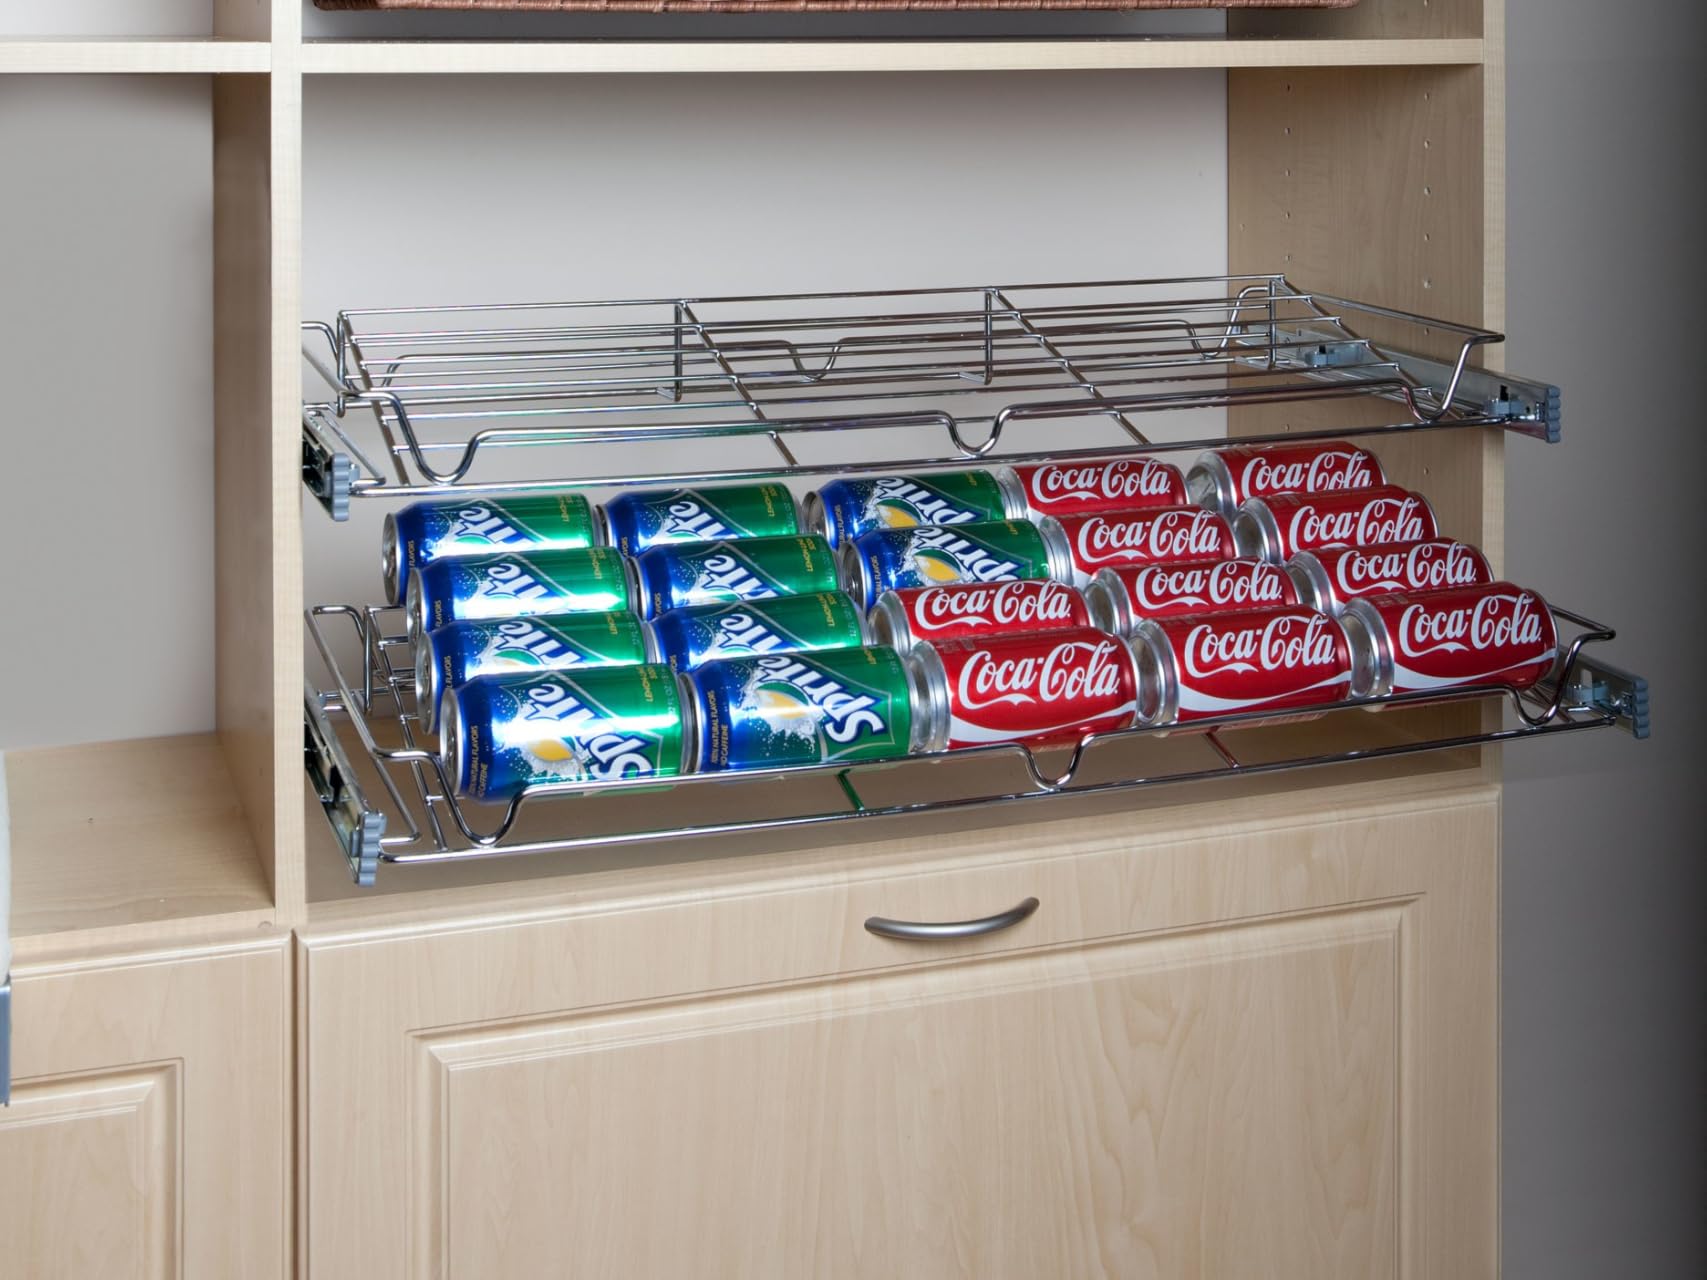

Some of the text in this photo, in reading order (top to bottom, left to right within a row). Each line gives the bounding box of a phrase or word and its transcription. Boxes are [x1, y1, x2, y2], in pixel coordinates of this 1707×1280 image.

[875, 477, 976, 525] prite
[1032, 458, 1170, 503] Coca-Cola
[1241, 451, 1373, 499] Coca-Cola
[1077, 510, 1221, 563] Coca-Cola
[1288, 498, 1425, 552] Coca-Cola
[1135, 559, 1283, 610] Coca-Cola
[1336, 540, 1477, 595] Coca-Cola
[914, 579, 1072, 630] Coca-Cola
[1399, 592, 1542, 658] Coca-Cola
[1184, 613, 1336, 679] Coca-Cola
[755, 656, 885, 743] Sprite
[958, 640, 1121, 710] Coca-Cola
[707, 690, 717, 718] FLAVORS
